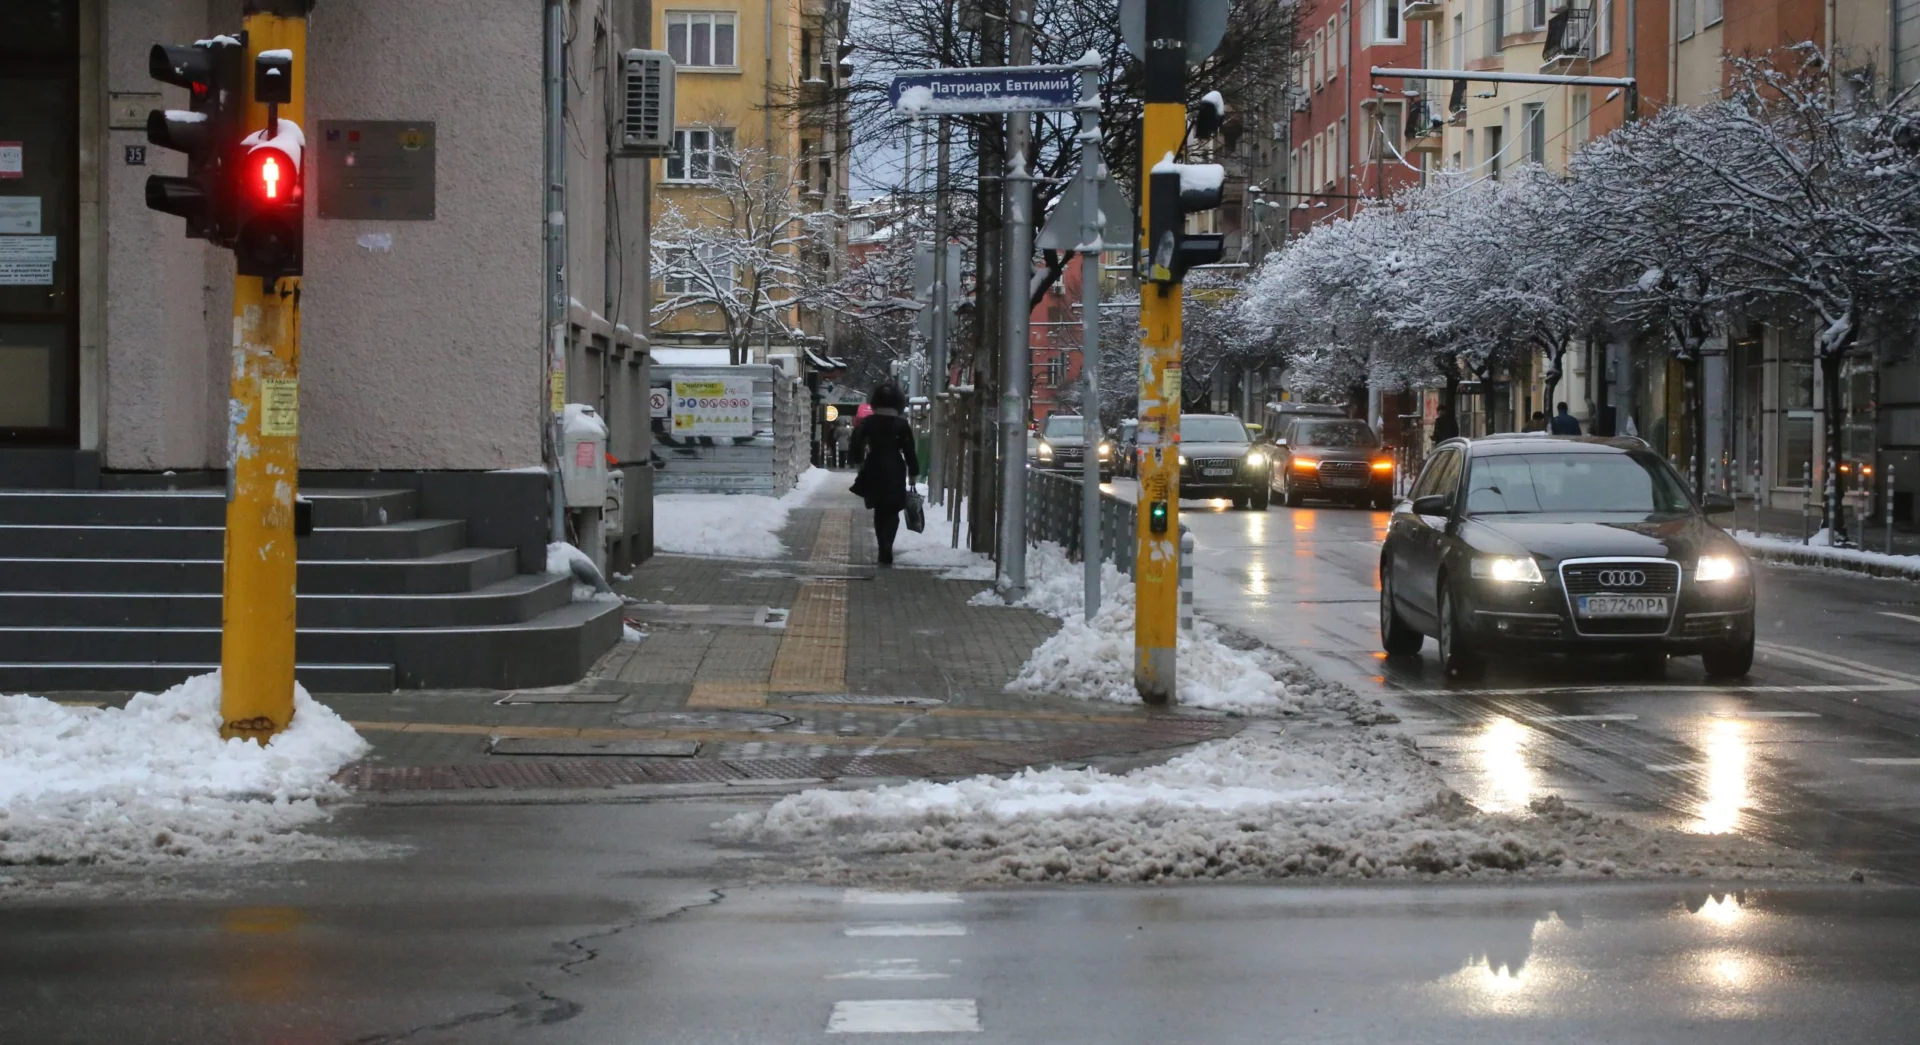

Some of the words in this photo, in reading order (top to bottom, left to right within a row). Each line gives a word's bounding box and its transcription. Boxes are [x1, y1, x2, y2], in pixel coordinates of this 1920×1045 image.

[930, 81, 1001, 97] Патриарх
[1006, 77, 1070, 92] Евтимий
[129, 148, 142, 160] 35
